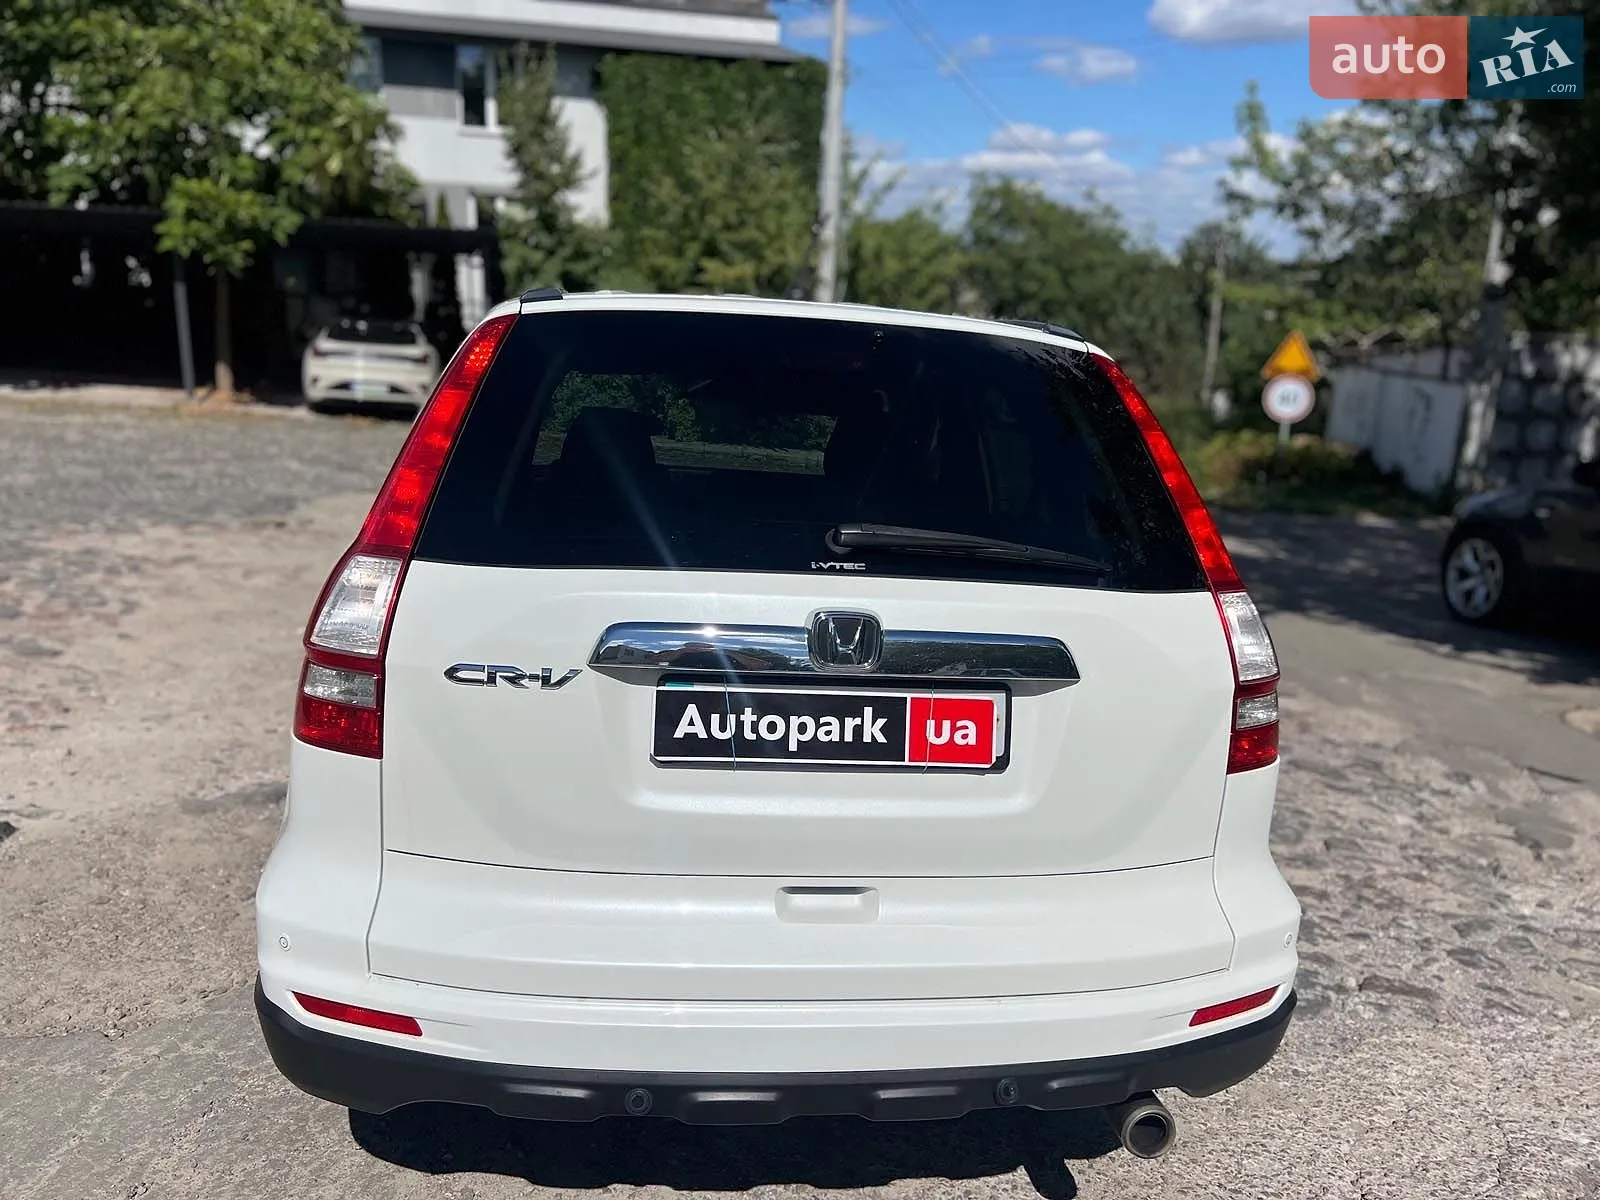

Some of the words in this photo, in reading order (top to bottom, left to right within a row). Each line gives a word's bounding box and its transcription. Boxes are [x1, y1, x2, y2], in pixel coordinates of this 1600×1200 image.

[443, 662, 583, 691] CR-V
[673, 703, 888, 752] Autopark
[926, 718, 977, 746] ua
